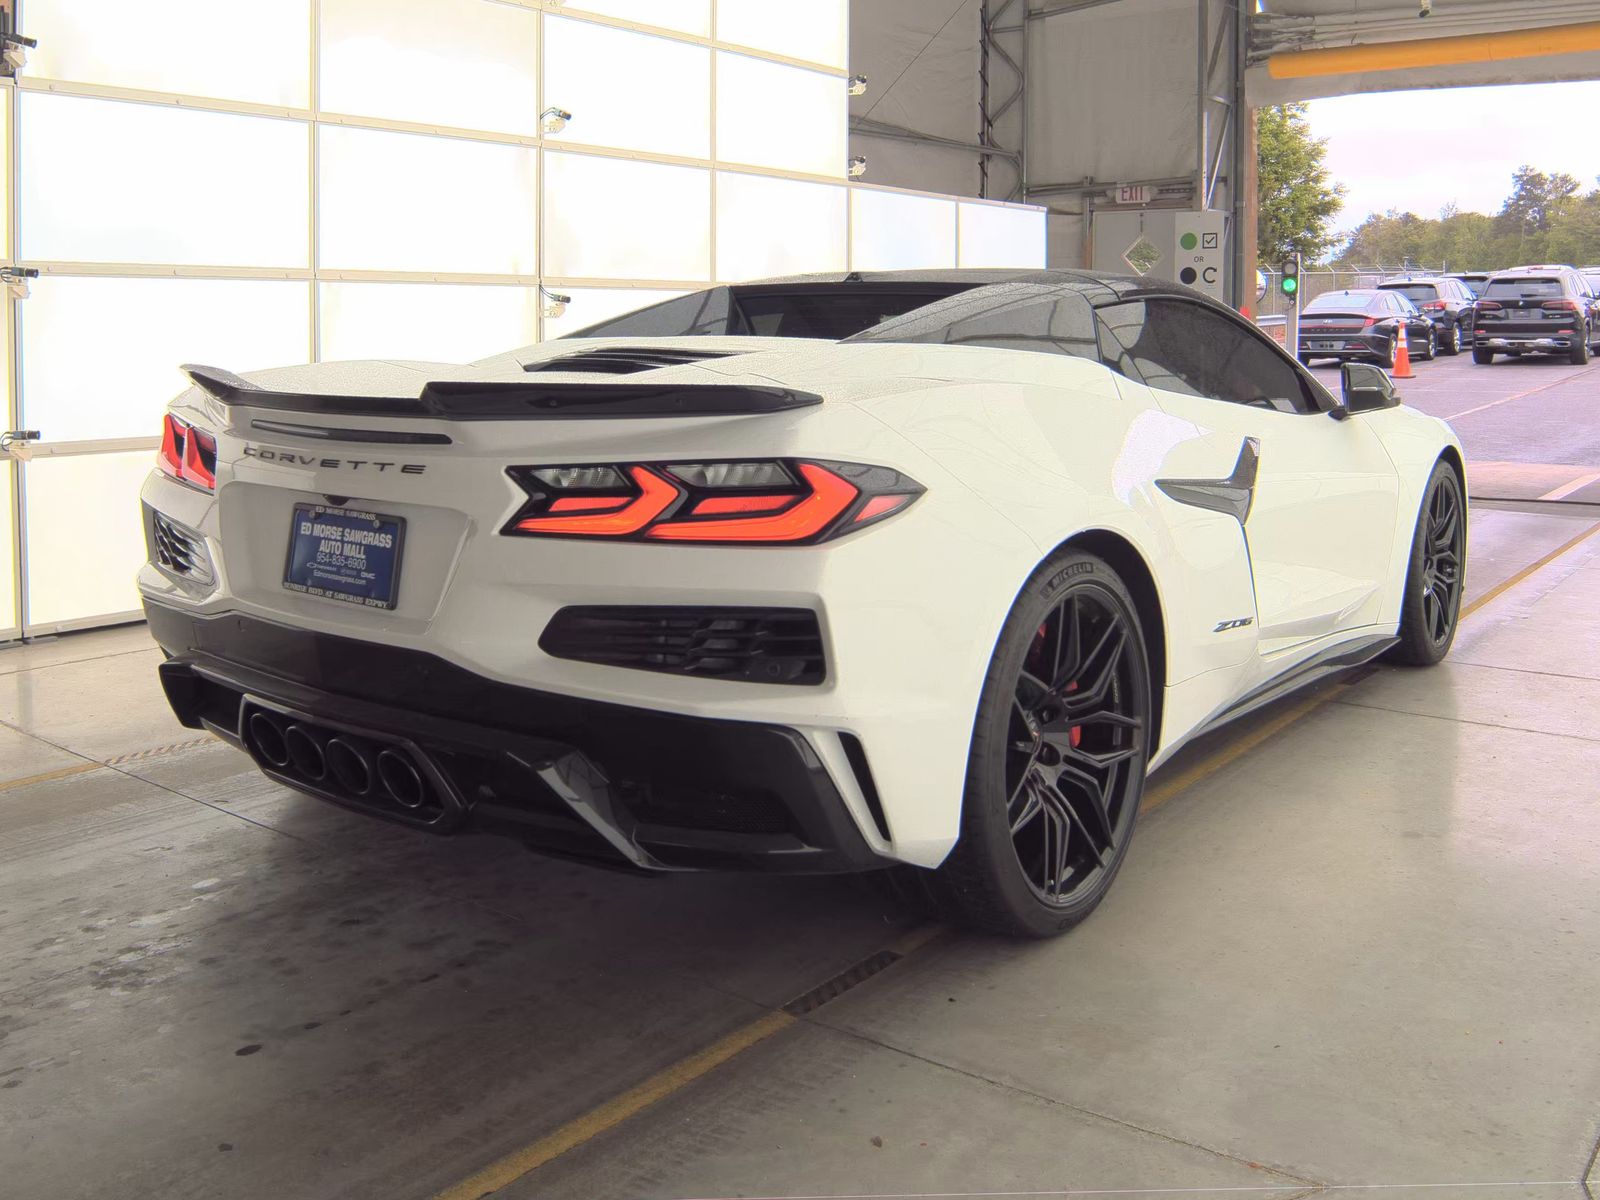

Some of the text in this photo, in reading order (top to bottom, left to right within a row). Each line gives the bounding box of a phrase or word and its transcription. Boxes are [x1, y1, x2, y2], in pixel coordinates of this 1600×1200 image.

[243, 447, 427, 474] CORVETTE
[346, 510, 377, 520] SAWGRASS
[301, 522, 393, 548] ED MORSE SAWGRASS
[319, 540, 366, 558] AUTO MALL
[316, 552, 367, 570] 954-835-6900
[1052, 562, 1092, 588] MICHELIN
[325, 591, 334, 599] AT
